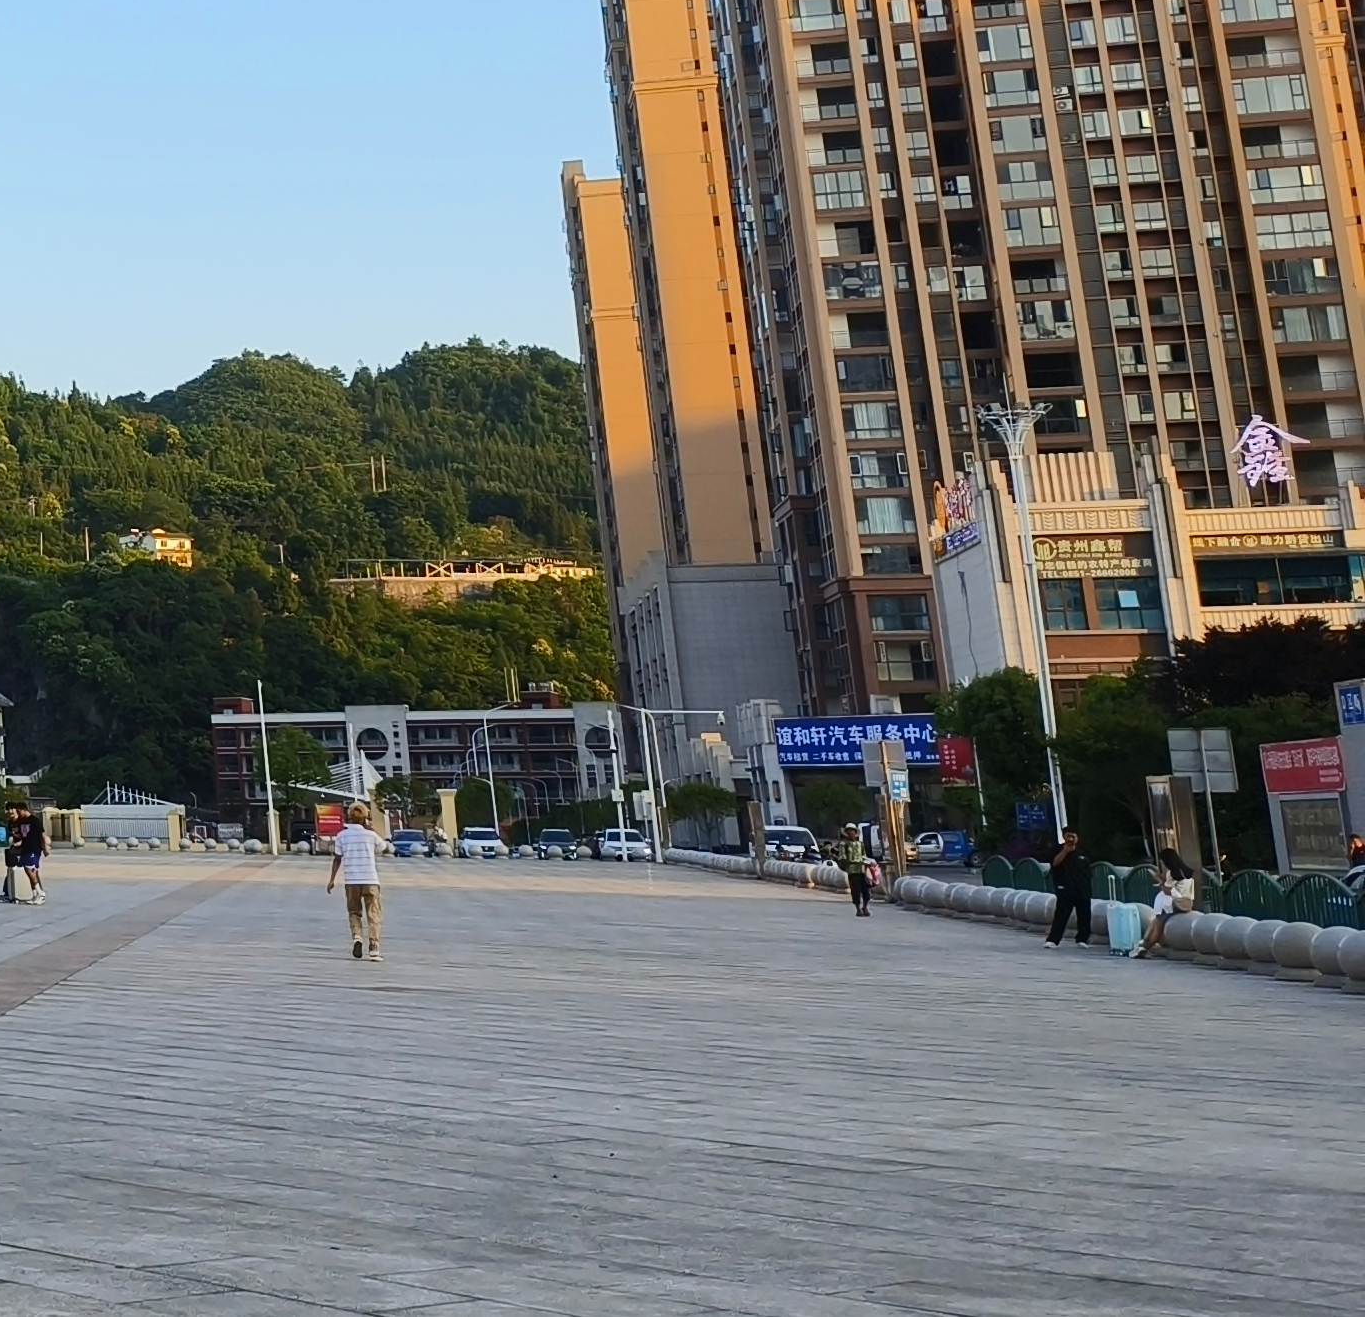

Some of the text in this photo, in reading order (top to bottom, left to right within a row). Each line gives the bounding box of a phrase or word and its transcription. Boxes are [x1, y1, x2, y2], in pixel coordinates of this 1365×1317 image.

[776, 724, 937, 746] 谊和轩汽车服务中心
